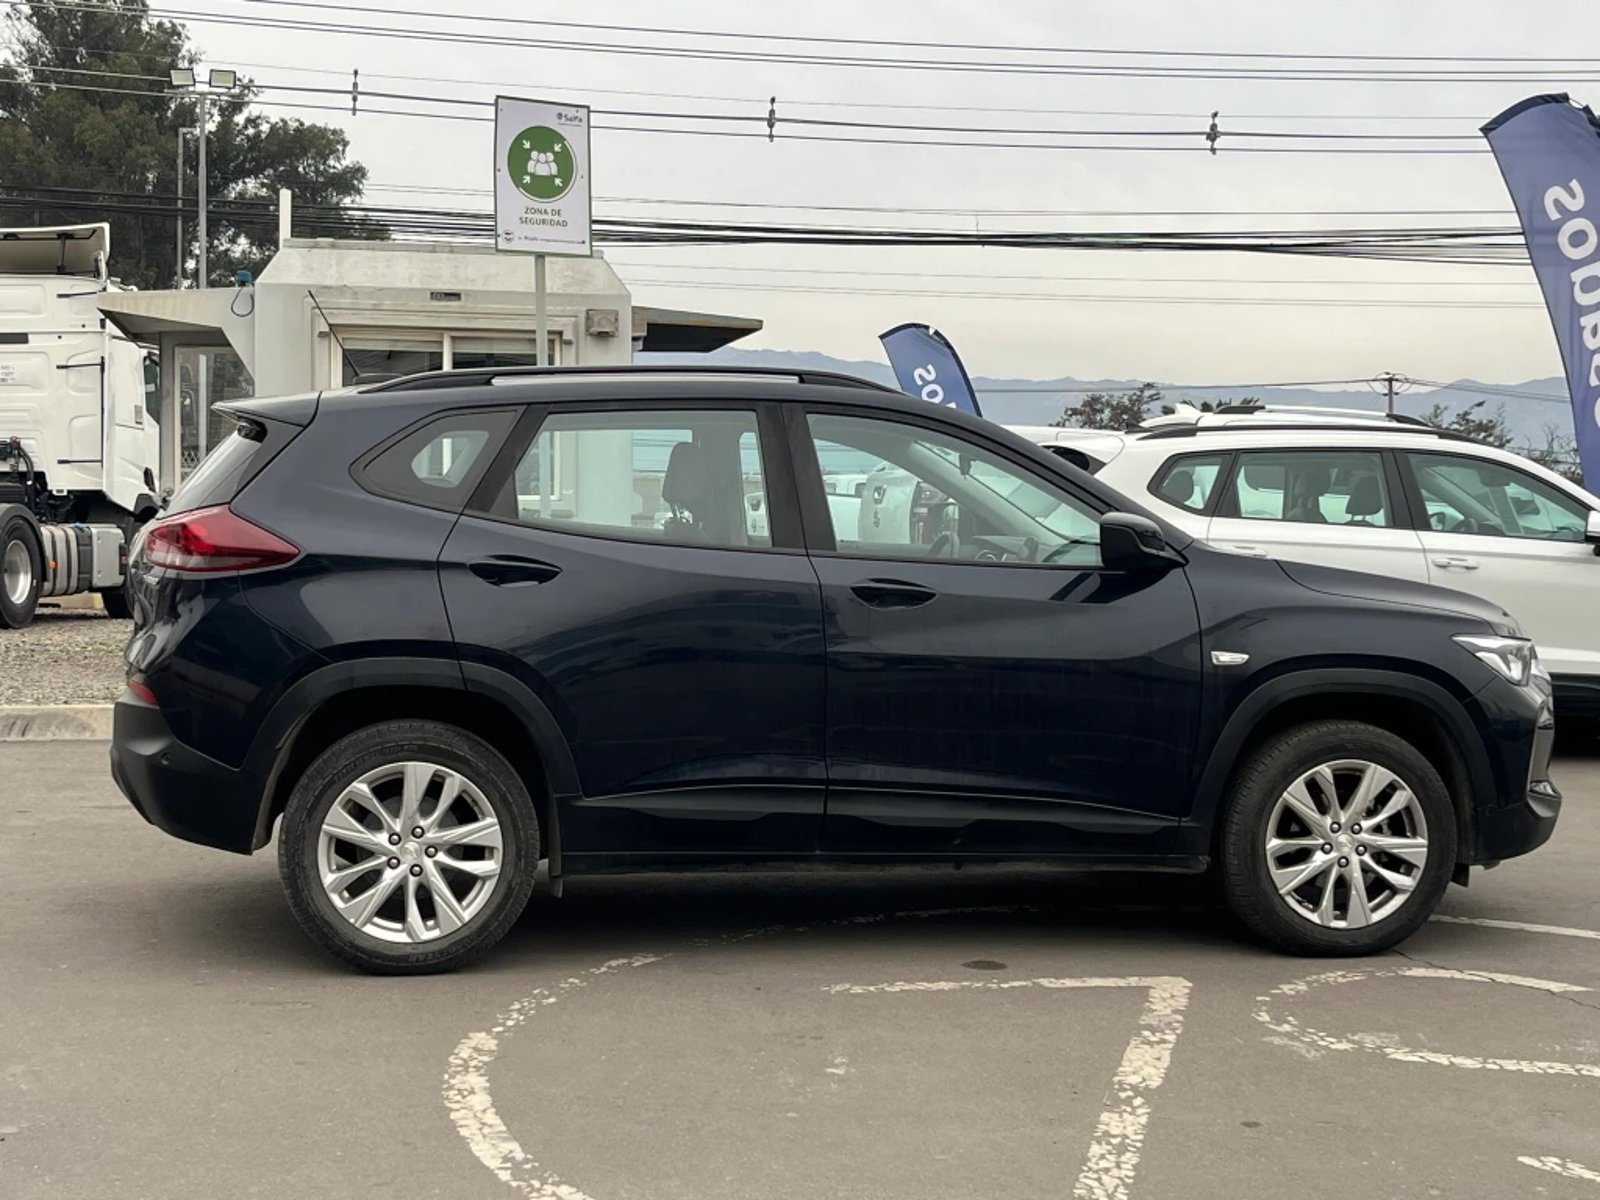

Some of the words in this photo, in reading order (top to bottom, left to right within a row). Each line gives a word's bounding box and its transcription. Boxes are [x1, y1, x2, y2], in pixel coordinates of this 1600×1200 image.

[524, 207, 549, 216] ZONA
[551, 208, 562, 217] DE
[519, 217, 568, 227] SEGURIDAD
